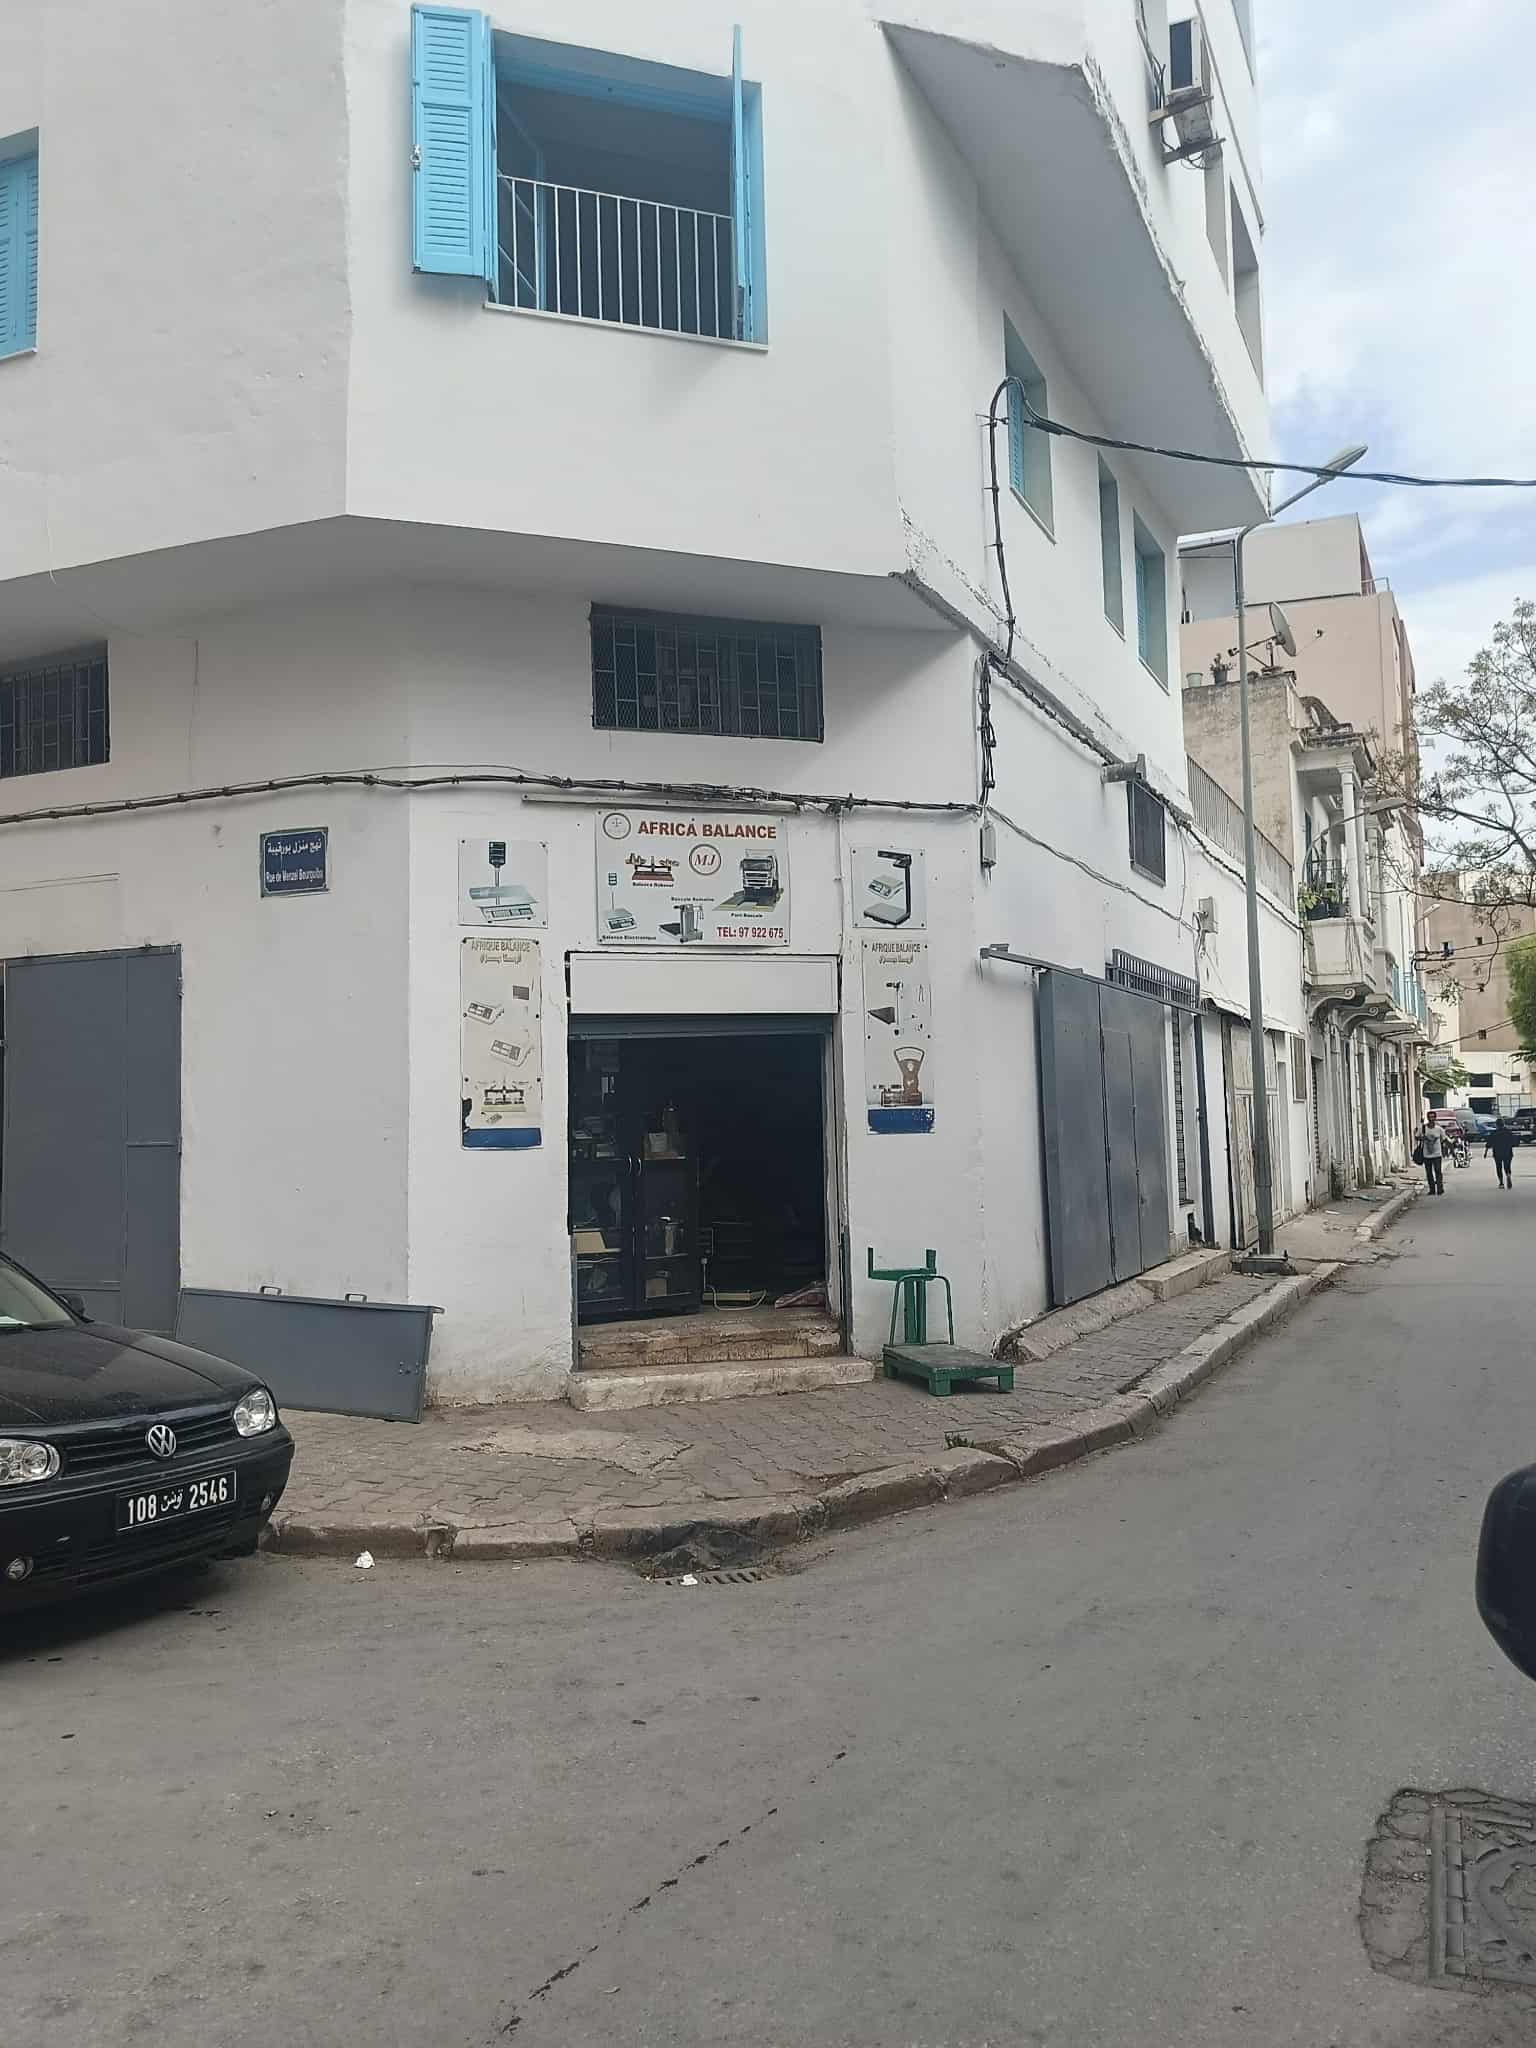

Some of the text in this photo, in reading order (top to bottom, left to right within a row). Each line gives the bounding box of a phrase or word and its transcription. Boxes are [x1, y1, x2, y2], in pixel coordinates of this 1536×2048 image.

[638, 821, 777, 839] AFRICA BALANCE
[694, 854, 716, 866] MJ
[717, 926, 737, 938] TEL:
[738, 927, 749, 938] 97
[752, 927, 767, 938] 922
[471, 940, 500, 952] AFRIQUE
[871, 942, 896, 953] AFRIQUE
[128, 1494, 157, 1525] 108
[189, 1477, 228, 1510] 2546
